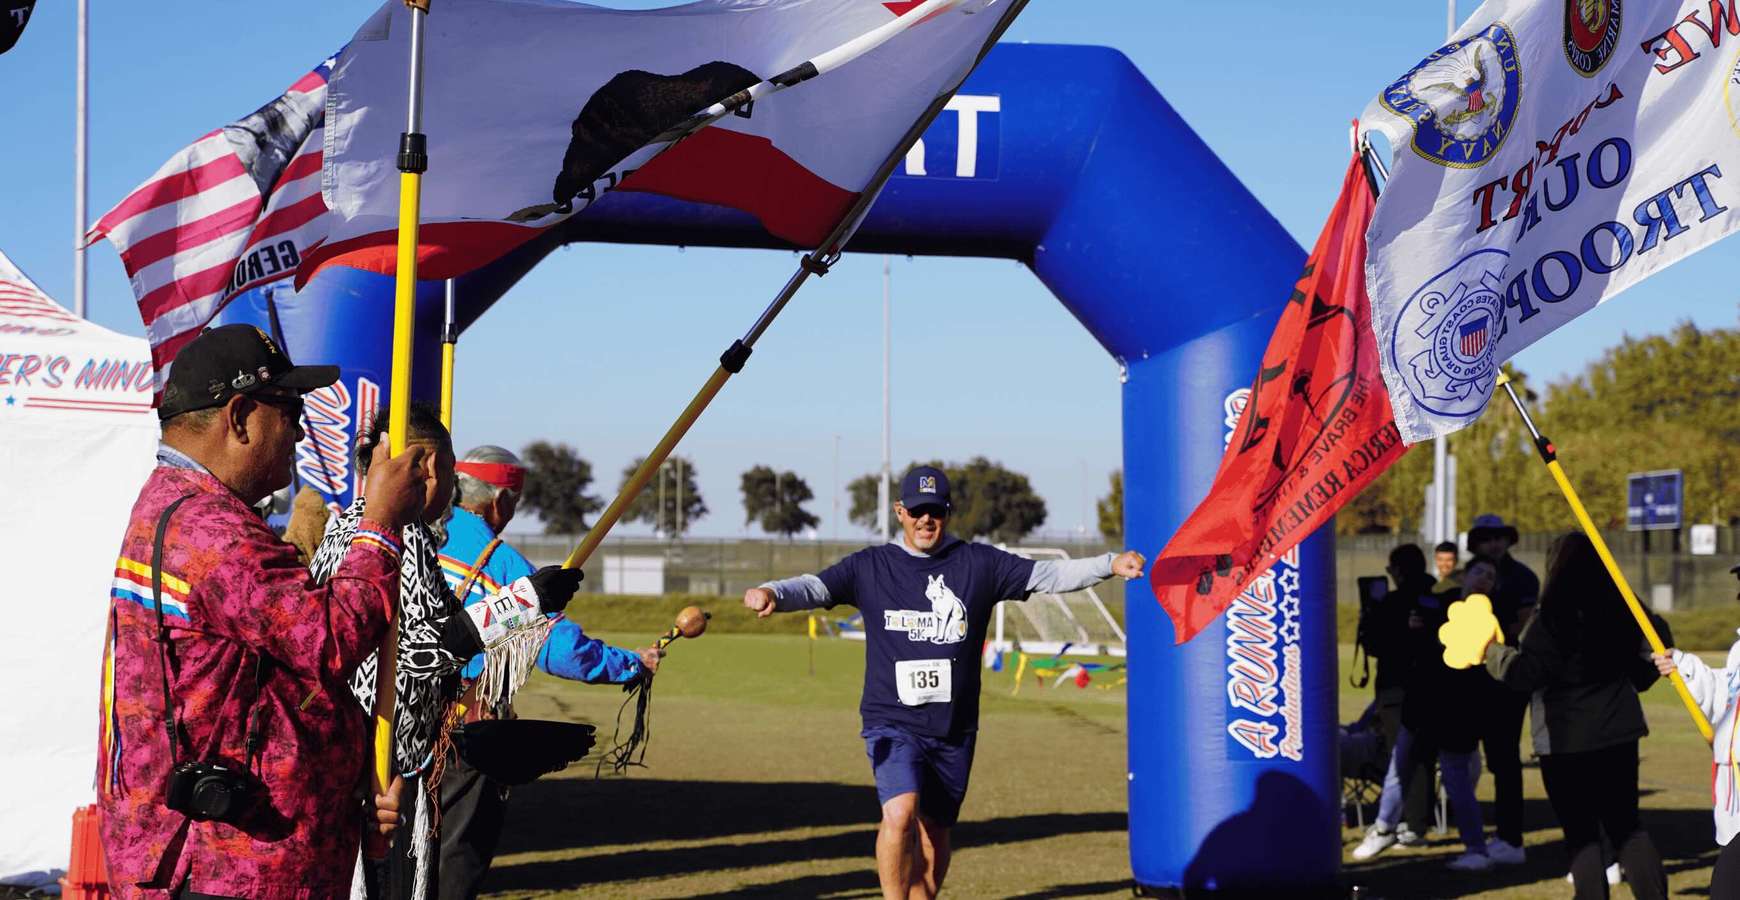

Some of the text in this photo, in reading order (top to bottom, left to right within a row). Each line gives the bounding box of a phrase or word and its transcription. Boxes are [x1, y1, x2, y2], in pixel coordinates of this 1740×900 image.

[0, 354, 71, 389] ER'S
[909, 670, 940, 689] 135
[1227, 718, 1279, 759] A
